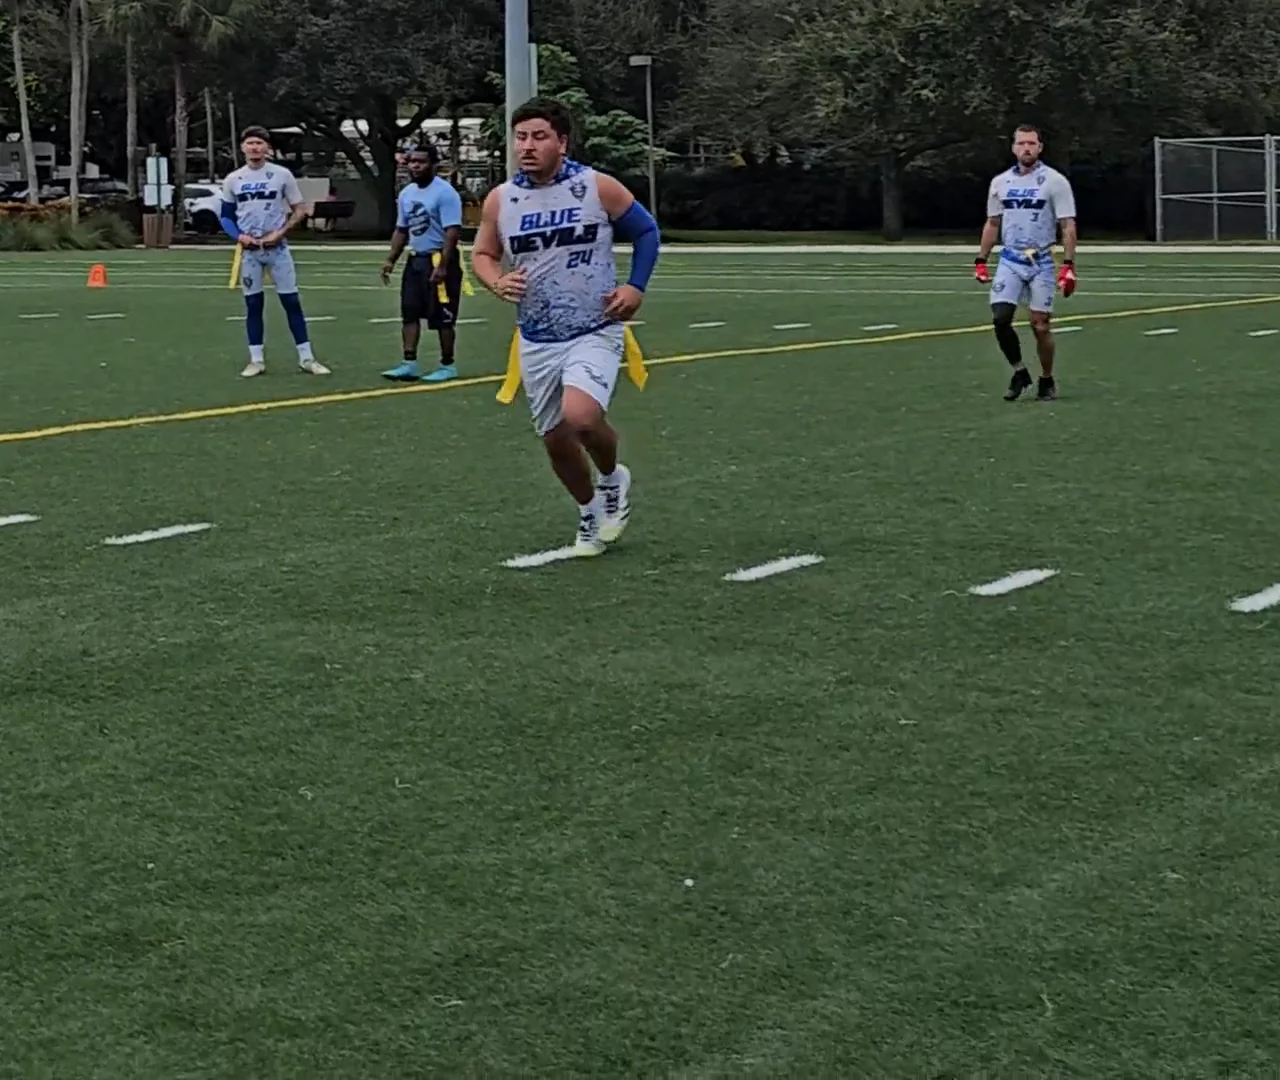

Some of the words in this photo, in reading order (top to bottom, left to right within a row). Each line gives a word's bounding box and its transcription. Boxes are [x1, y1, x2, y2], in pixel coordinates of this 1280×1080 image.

[1007, 188, 1040, 198] BLUE
[520, 207, 581, 232] BLUE
[509, 223, 599, 255] DEVILS
[566, 249, 593, 269] 24
